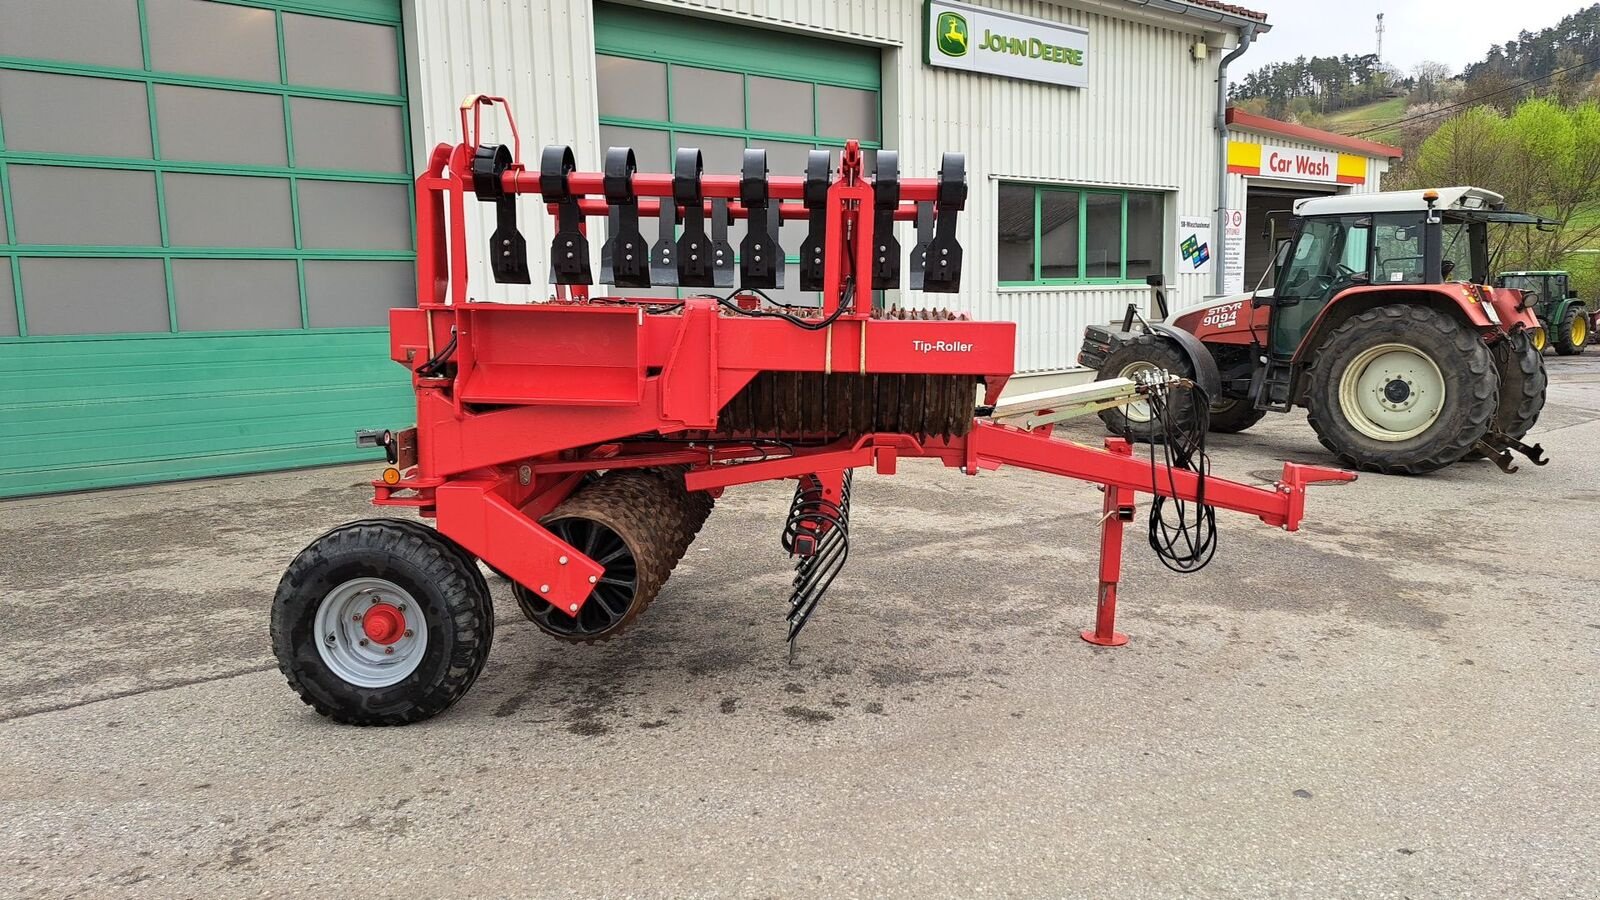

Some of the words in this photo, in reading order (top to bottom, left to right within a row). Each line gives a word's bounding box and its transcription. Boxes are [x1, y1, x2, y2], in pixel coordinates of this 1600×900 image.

[979, 29, 1027, 57] JOHN
[1029, 37, 1083, 66] DEERE
[1269, 152, 1292, 173] Car
[1296, 155, 1329, 176] Wash
[1207, 302, 1243, 316] STEYR
[1203, 311, 1237, 327] 9094
[912, 340, 973, 354] Tip-Roller
